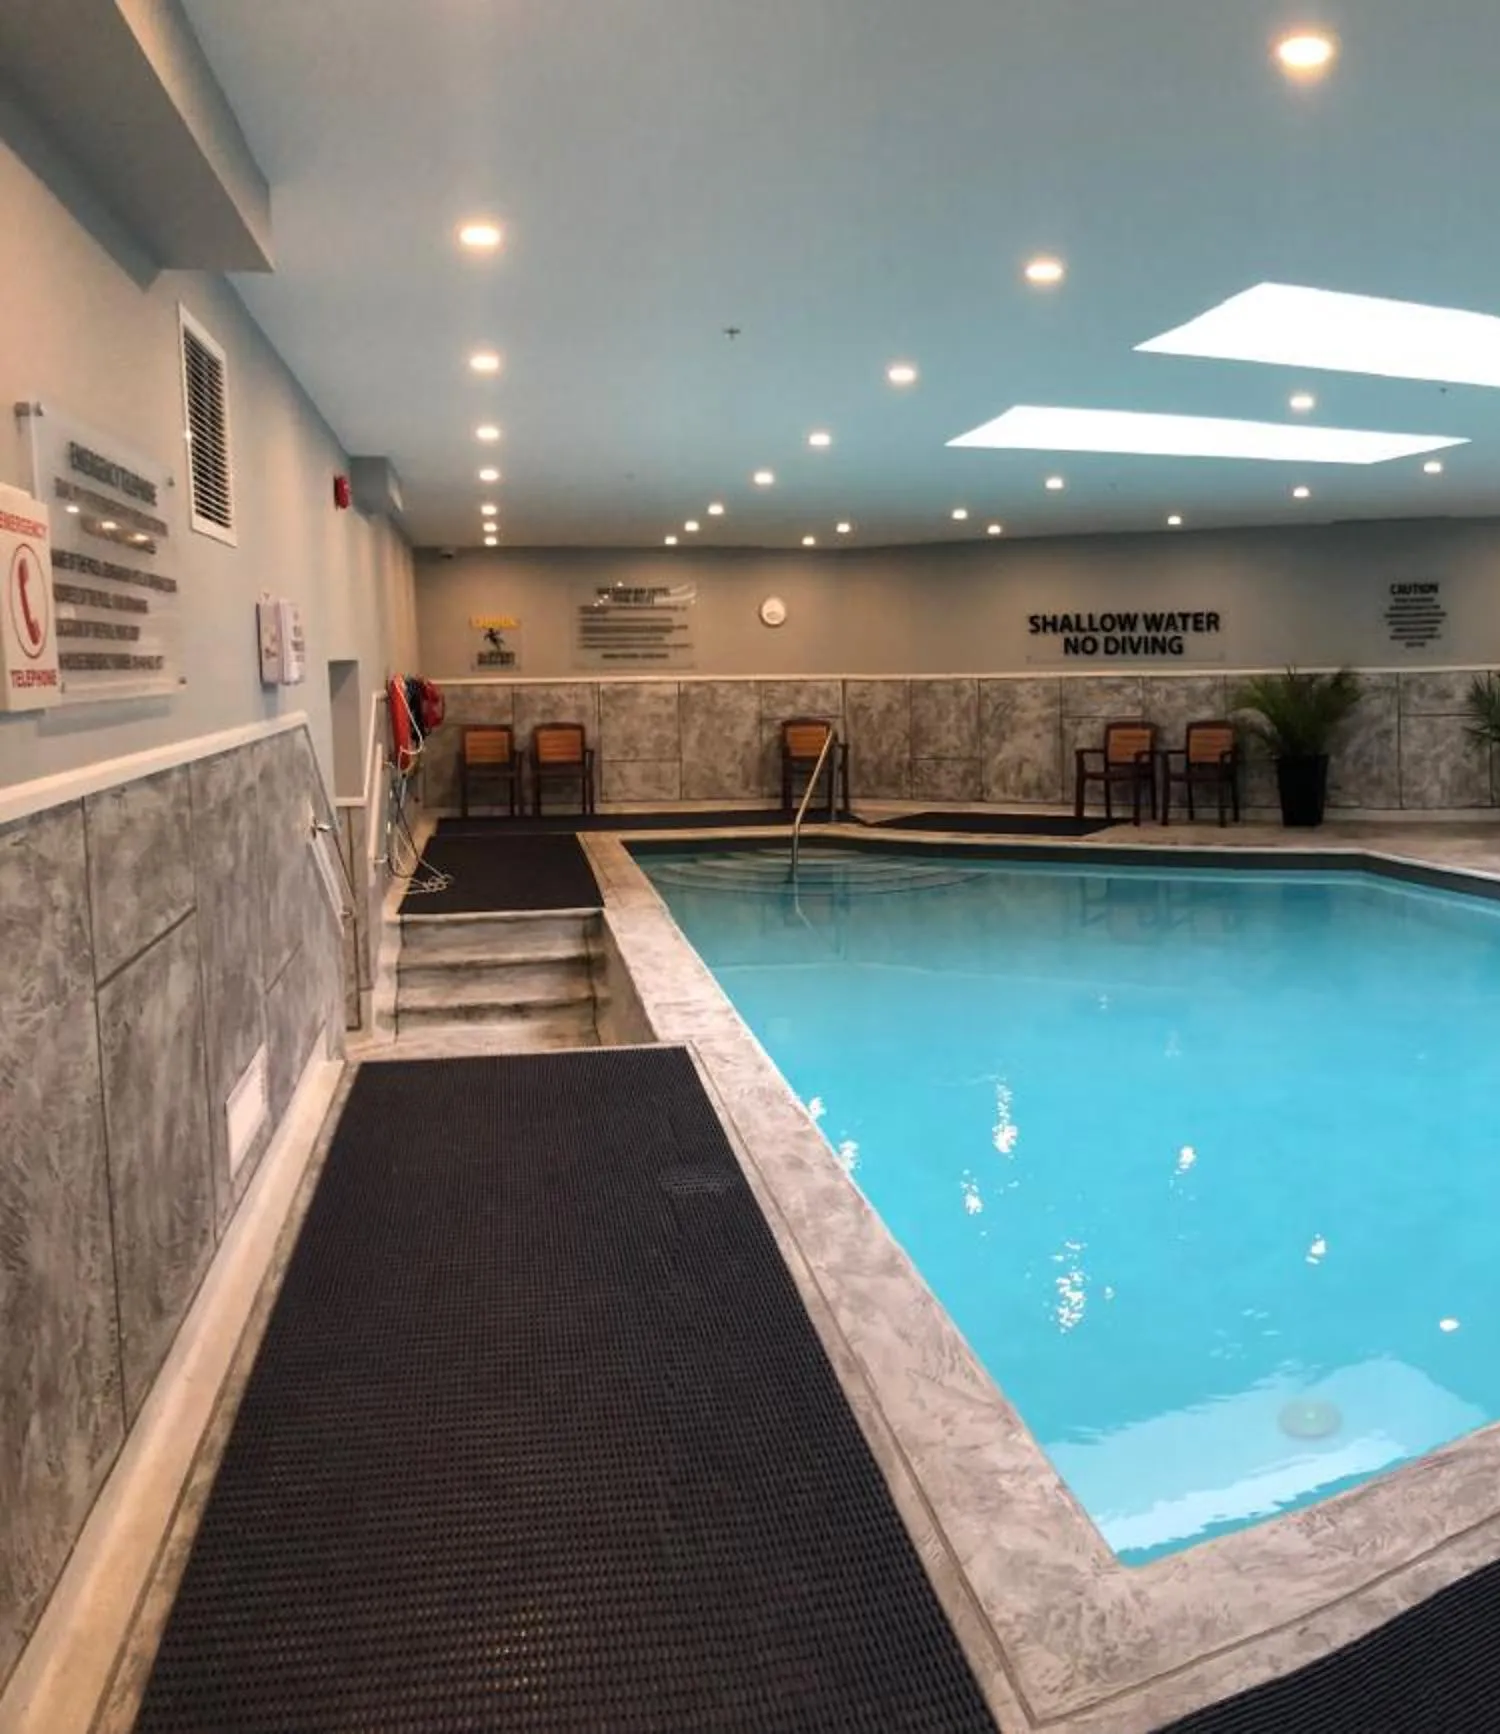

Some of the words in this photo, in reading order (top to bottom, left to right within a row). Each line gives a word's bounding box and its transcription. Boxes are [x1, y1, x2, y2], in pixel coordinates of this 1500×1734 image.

[1390, 583, 1439, 595] CAUTION
[1029, 613, 1138, 634] SHALLOW
[1143, 612, 1220, 633] WATER
[1063, 635, 1098, 655] NO
[1104, 635, 1184, 655] DIVING
